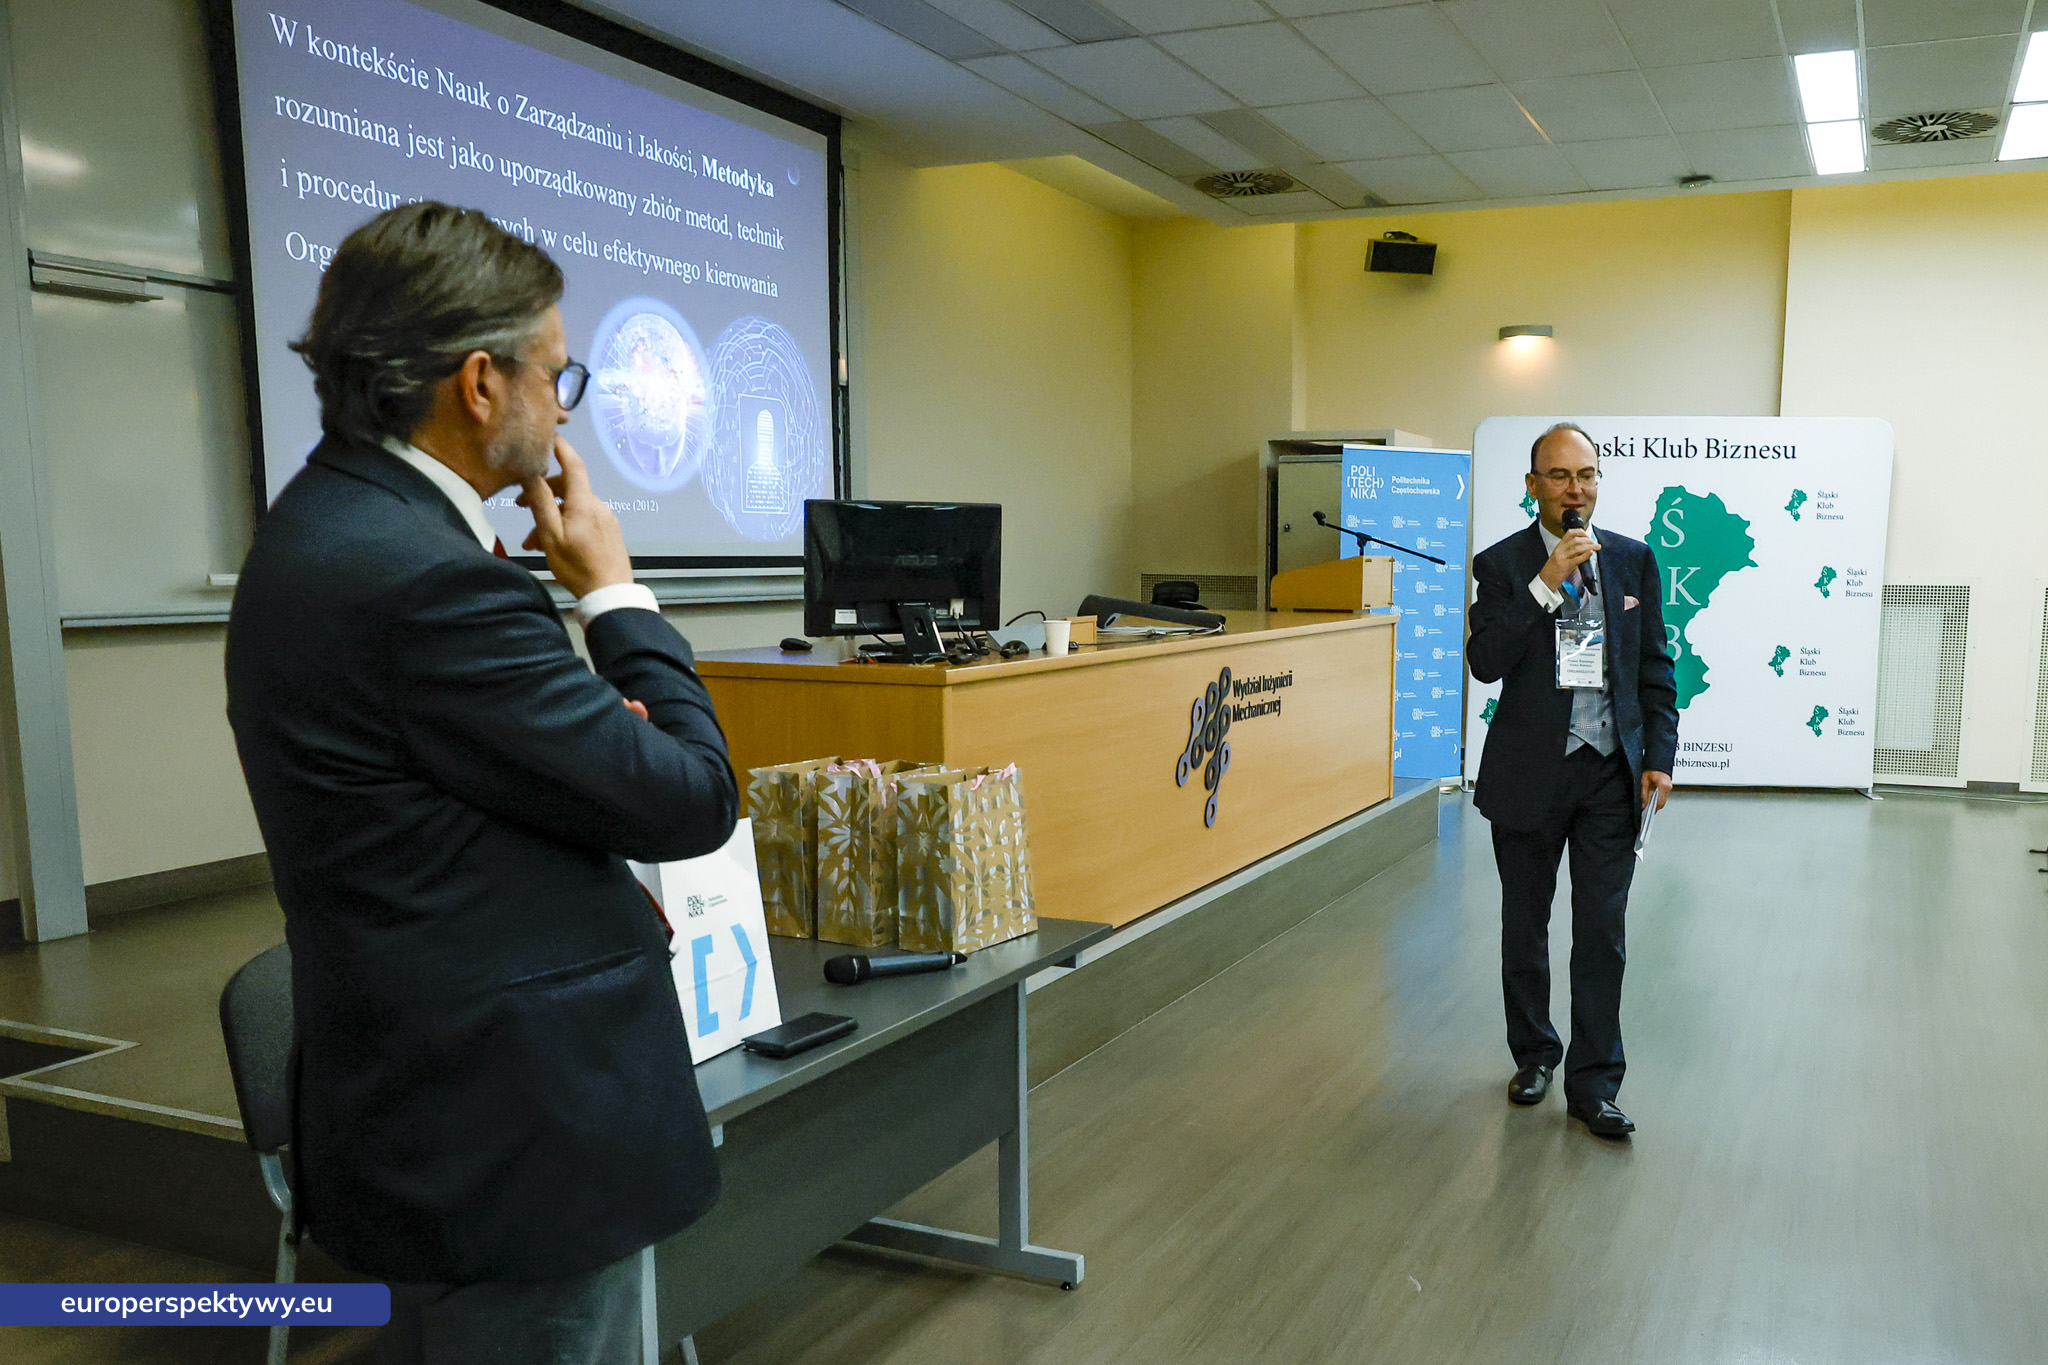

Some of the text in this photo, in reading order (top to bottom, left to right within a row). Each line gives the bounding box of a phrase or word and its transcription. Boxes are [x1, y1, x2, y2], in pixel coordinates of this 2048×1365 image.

[268, 12, 775, 198] W kontekście Nauk o Zarządzaniu i Jakości, Metodyka
[274, 95, 785, 250] rozumiana jest jako uporządkowany zbiór metod, technik
[280, 158, 779, 298] i procedur w celu efektywnego kierowania
[1642, 437, 1698, 459] Klub
[1704, 438, 1797, 460] Biznesu
[1350, 465, 1376, 477] POLI
[1391, 475, 1430, 485] Politechnika
[1350, 488, 1377, 499] NIKA
[1391, 486, 1440, 495] Częstochowska
[632, 499, 659, 513] (2012)
[1816, 512, 1844, 520] Biznesu
[1846, 579, 1864, 587] Klub
[1845, 590, 1873, 598] Biznesu
[1800, 658, 1817, 666] Klub
[1799, 669, 1827, 677] Biznesu
[1232, 696, 1281, 723] Mechanicznej
[1837, 728, 1865, 736] Biznesu
[1683, 742, 1733, 753] BINZESU
